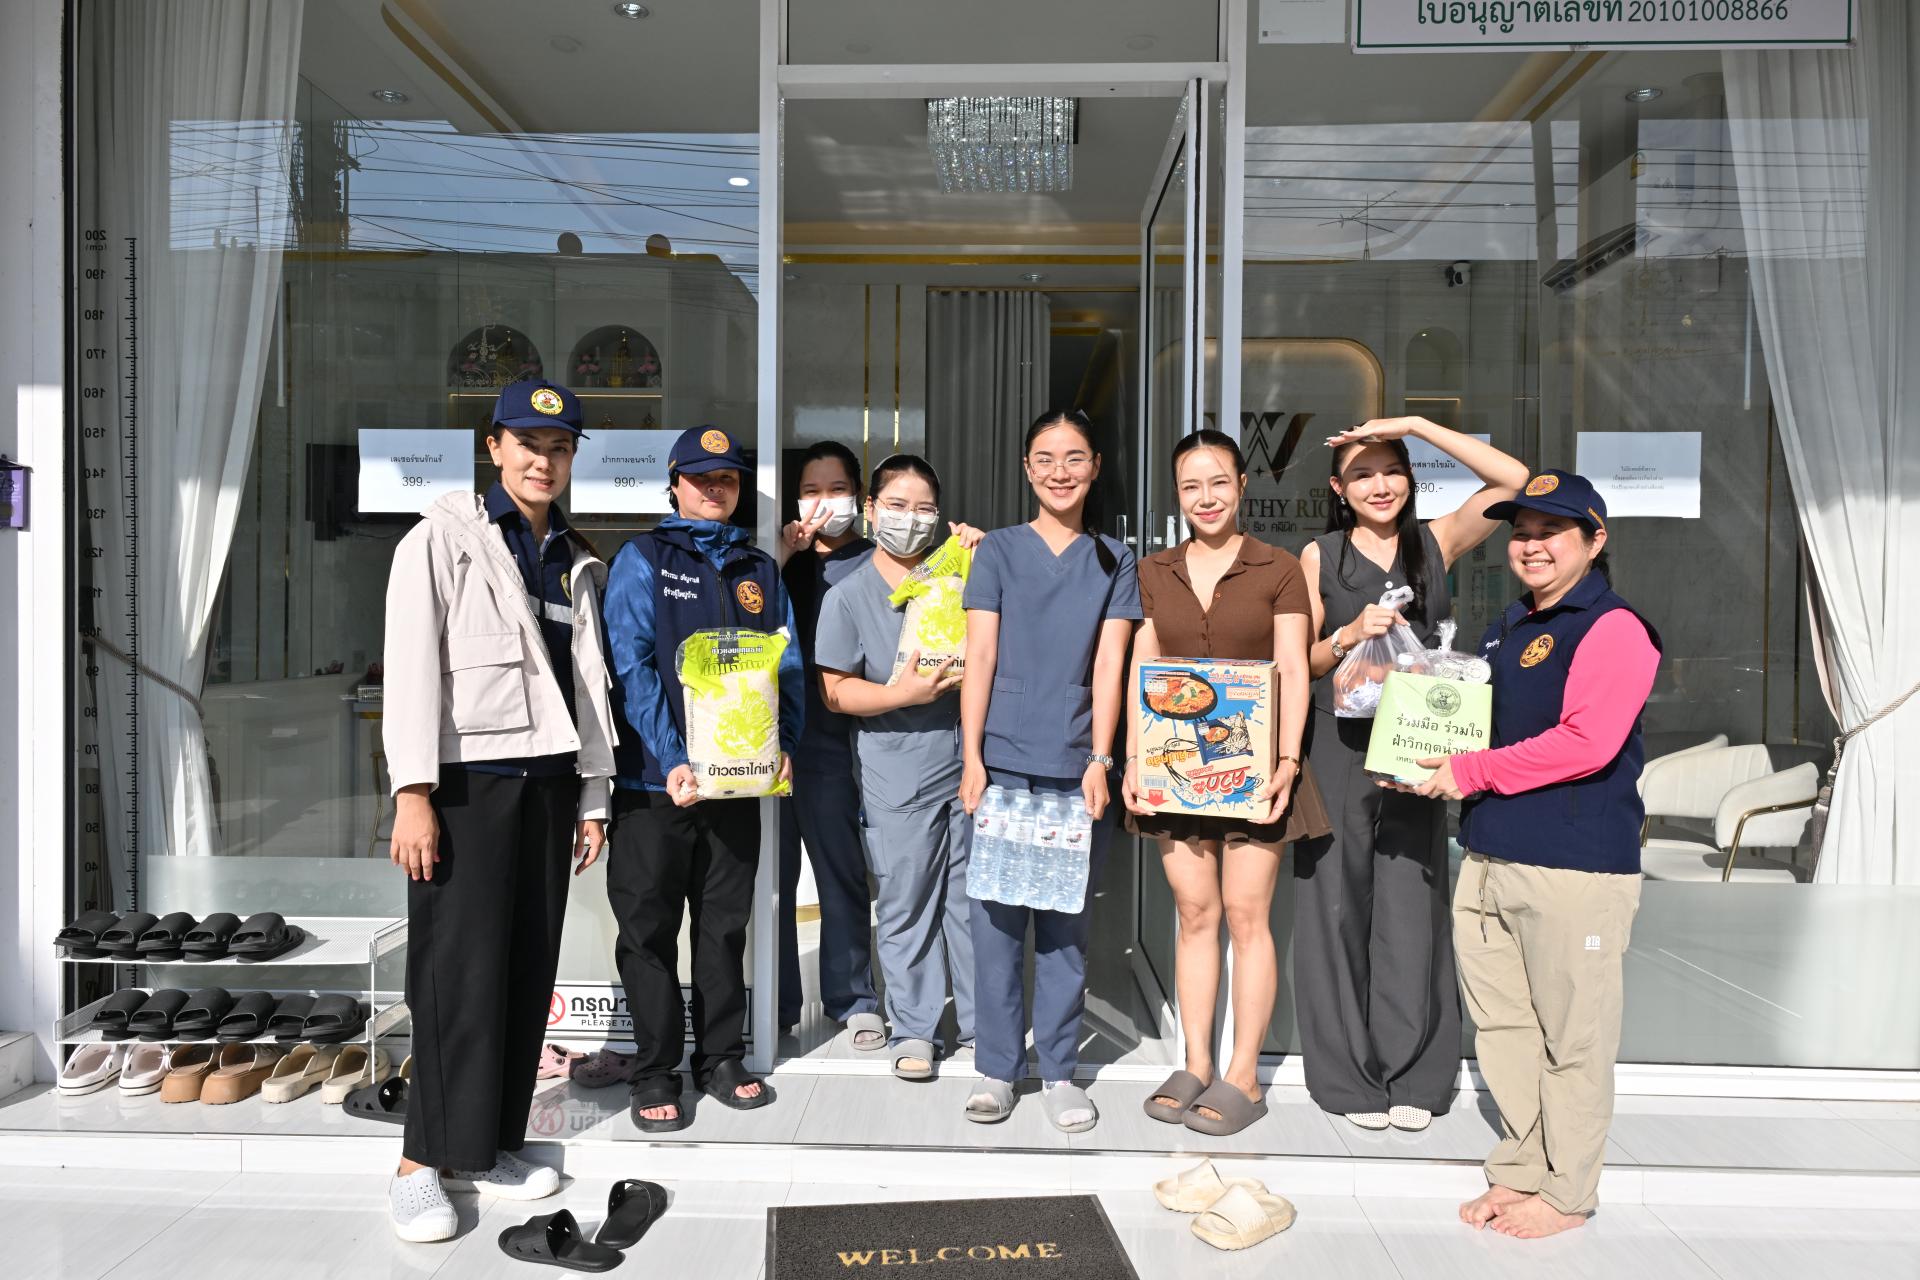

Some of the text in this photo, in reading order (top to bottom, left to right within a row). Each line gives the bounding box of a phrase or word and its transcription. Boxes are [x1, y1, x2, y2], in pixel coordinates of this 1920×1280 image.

[1417, 0, 1788, 35] ใบอนุญาตเลขท 20101008866
[402, 476, 431, 488] 399.-
[614, 477, 643, 488] 990.-
[1309, 488, 1329, 498] CLI
[1295, 499, 1329, 518] RIC
[1396, 713, 1483, 738] ร่วมมือ ร่วมใจ
[708, 761, 775, 776] ข้าวตราไก่แจ้
[571, 997, 629, 1019] กรุณา
[581, 1019, 633, 1027] PLEASE TA
[837, 1243, 1062, 1267] WELCOME
